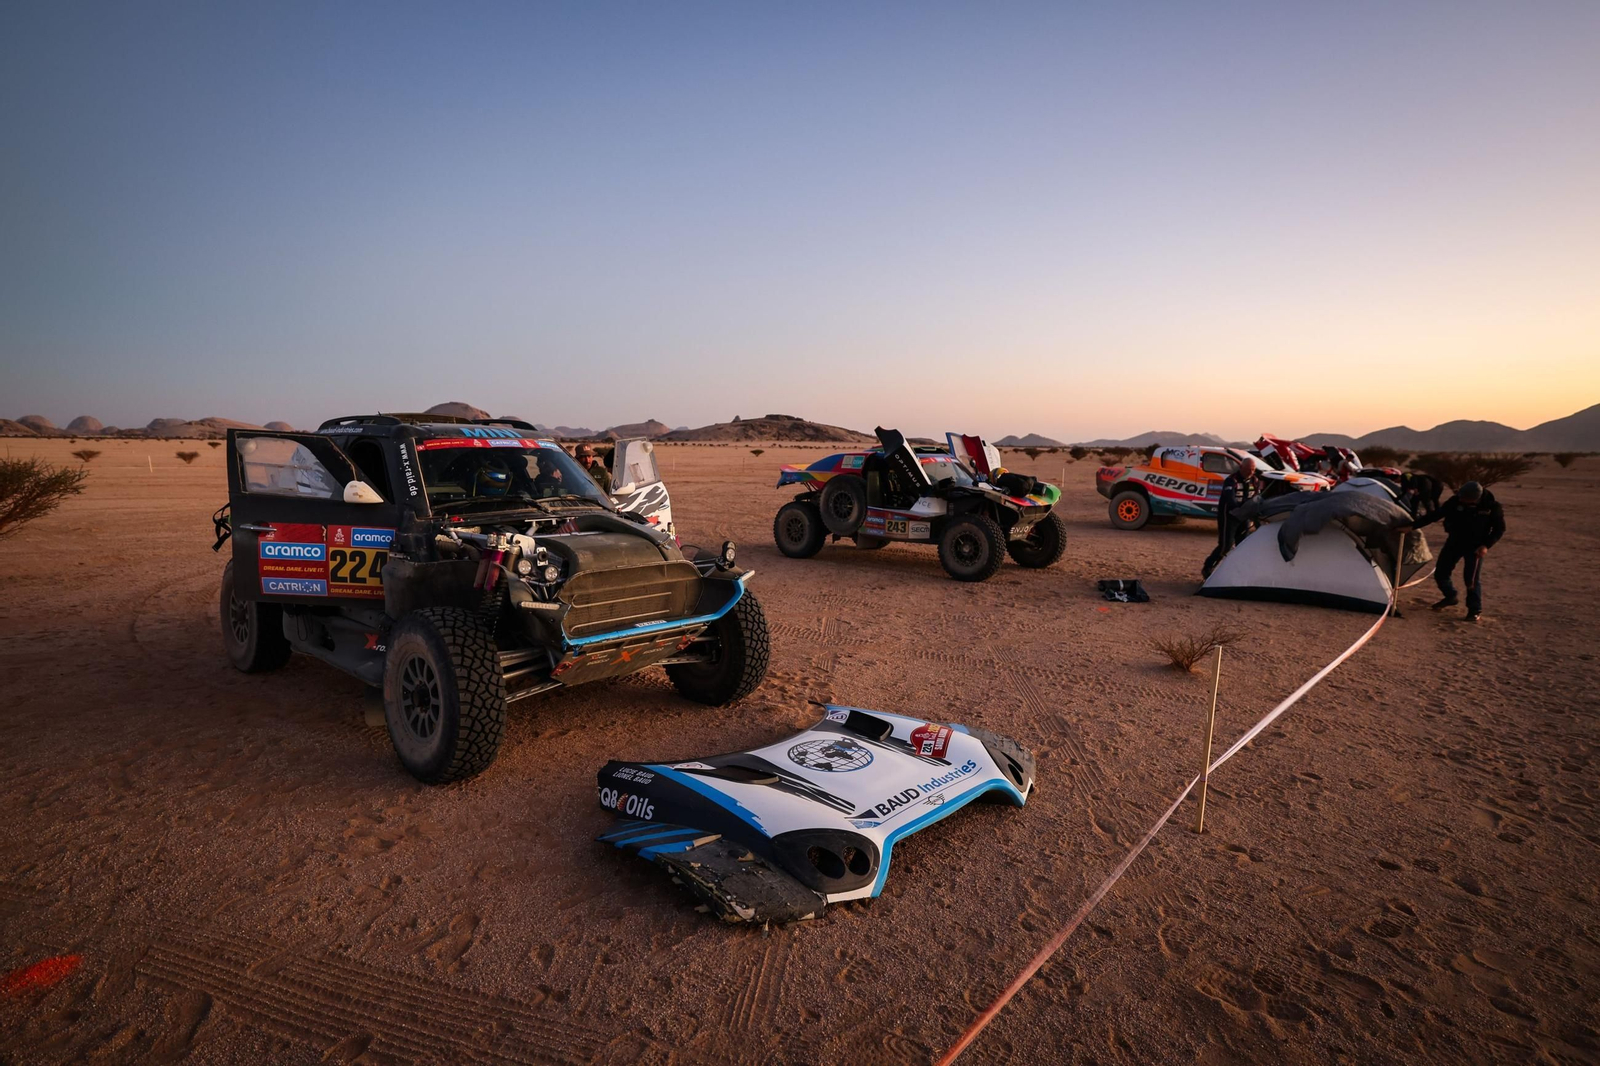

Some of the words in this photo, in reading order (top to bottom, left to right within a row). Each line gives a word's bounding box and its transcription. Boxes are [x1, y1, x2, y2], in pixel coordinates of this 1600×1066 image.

[460, 427, 522, 438] MINI
[399, 443, 417, 496] www.x-raid.de
[894, 454, 921, 488] OPTIMUS
[1144, 473, 1206, 497] REPSOL
[887, 520, 907, 533] 243
[353, 534, 393, 543] aramco
[265, 545, 321, 557] aramco
[329, 549, 388, 585] 224
[922, 743, 933, 753] 224
[612, 771, 634, 781] LIONEL
[633, 776, 652, 785] BAUD
[636, 771, 655, 779] BAUD
[874, 788, 921, 817] BAUD
[916, 759, 977, 794] Industries
[600, 787, 618, 809] Q8
[626, 794, 655, 820] Oils
